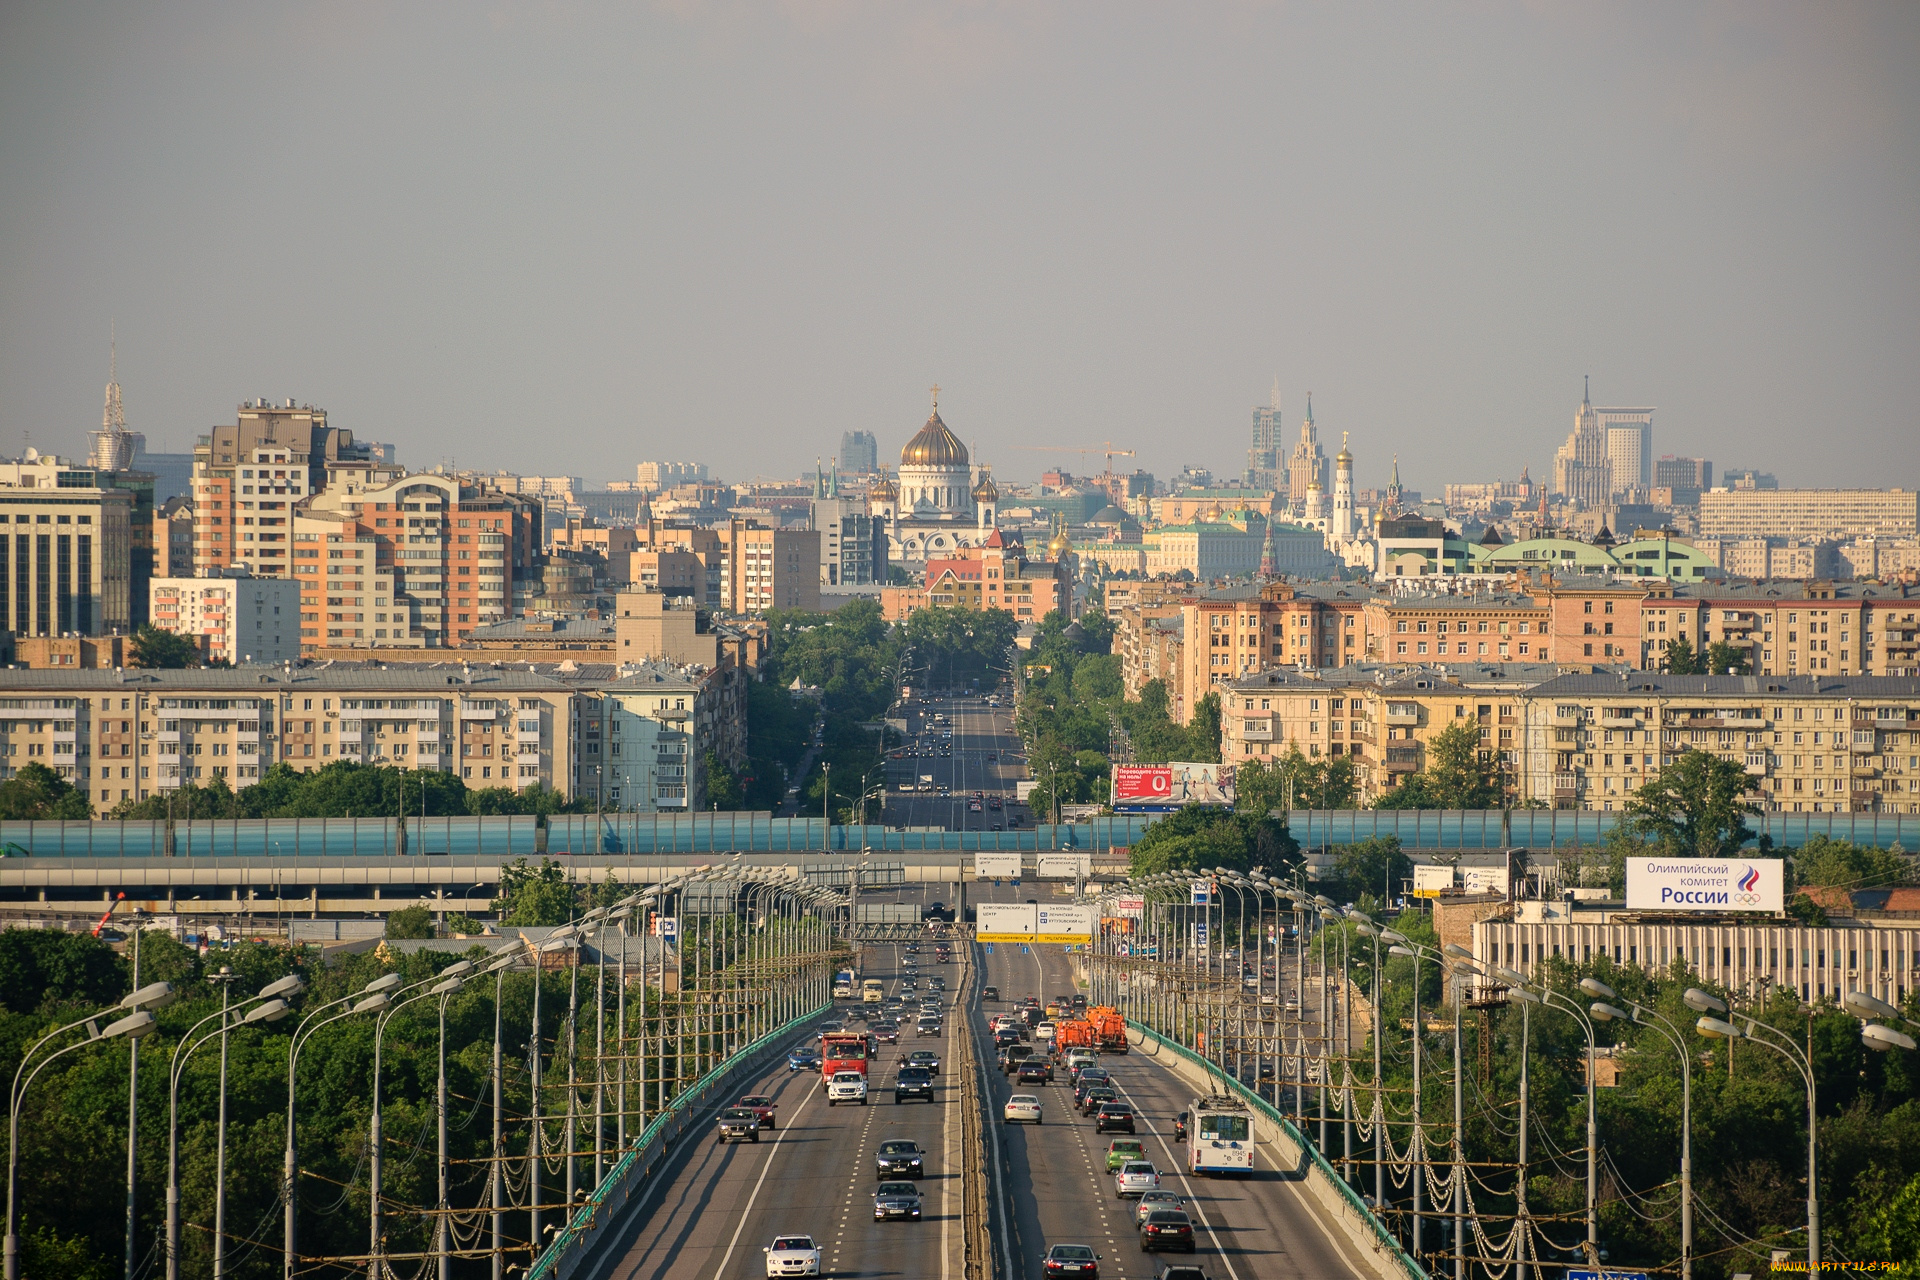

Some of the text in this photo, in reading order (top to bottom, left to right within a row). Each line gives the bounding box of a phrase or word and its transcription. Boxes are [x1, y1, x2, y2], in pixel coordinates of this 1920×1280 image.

[1152, 775, 1166, 792] 0
[1647, 862, 1729, 874] Олимпийский
[1680, 878, 1729, 887] комитет
[1661, 887, 1729, 904] России
